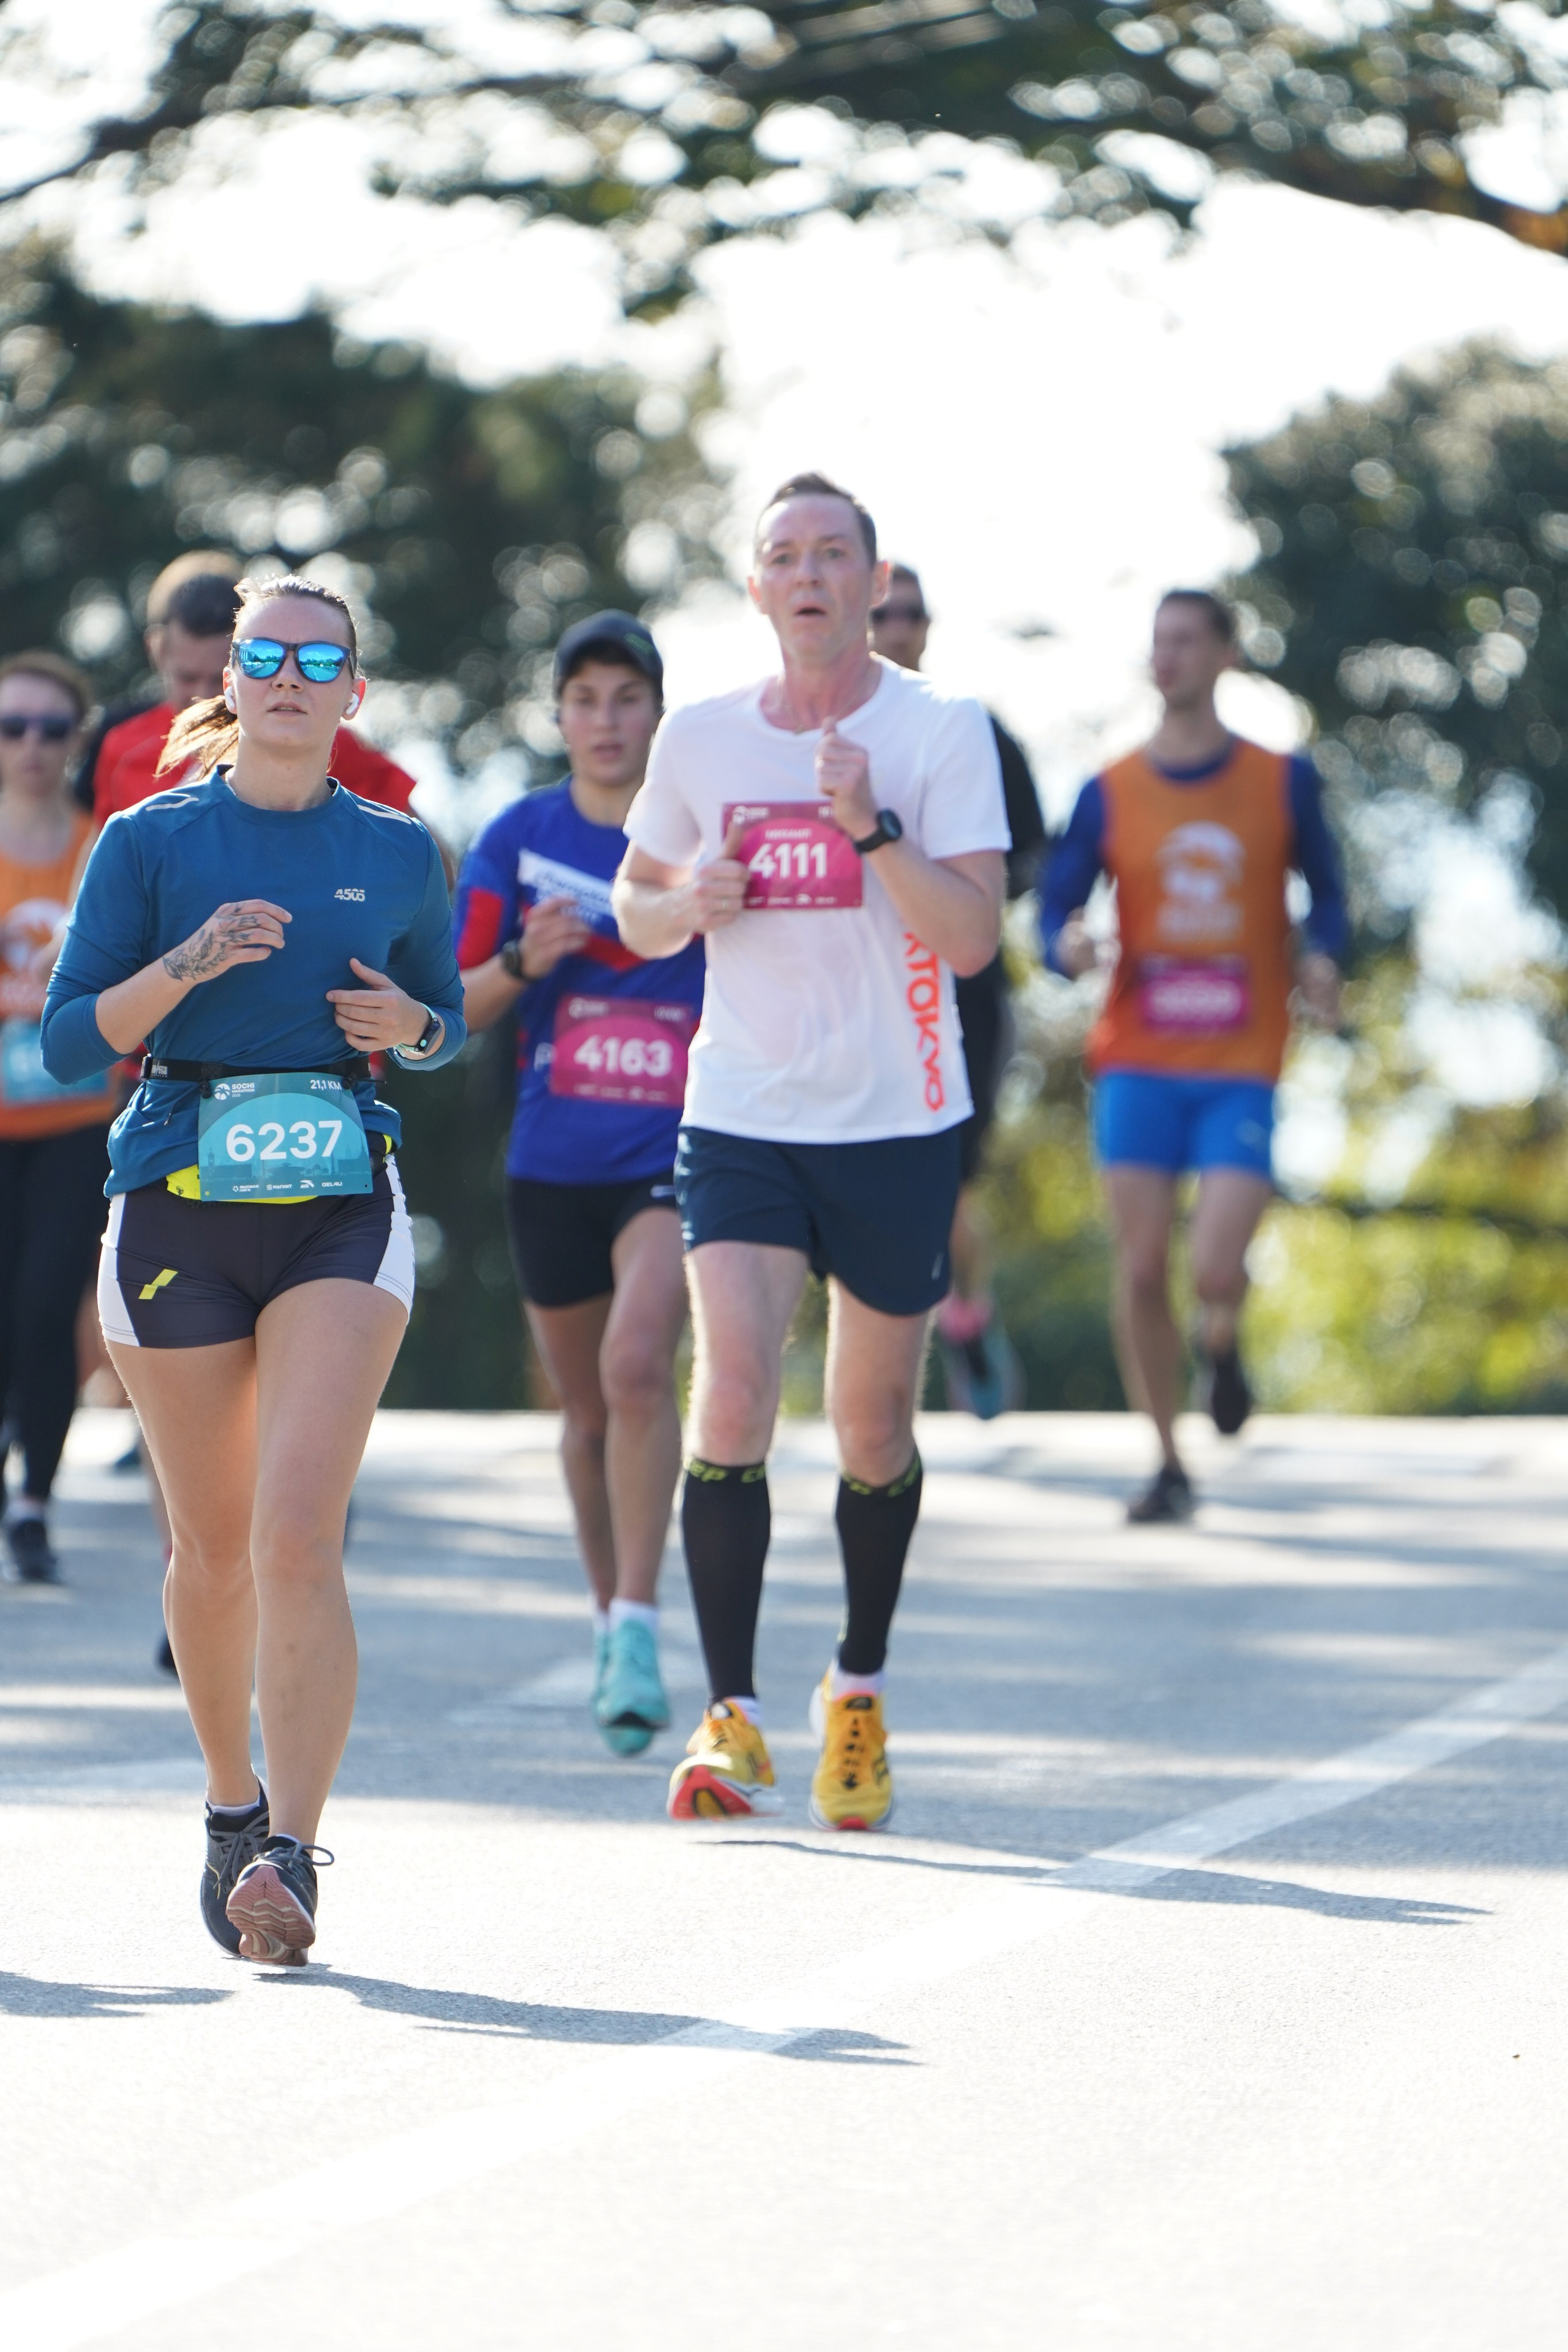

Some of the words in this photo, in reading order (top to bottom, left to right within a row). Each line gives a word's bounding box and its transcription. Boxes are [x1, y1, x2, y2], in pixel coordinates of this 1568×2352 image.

[748, 842, 827, 880] 4111
[334, 888, 366, 902] 4505
[573, 1034, 673, 1078] 4163
[310, 1079, 326, 1090] 21,1
[327, 1080, 342, 1090] KM
[226, 1120, 342, 1162] 6237
